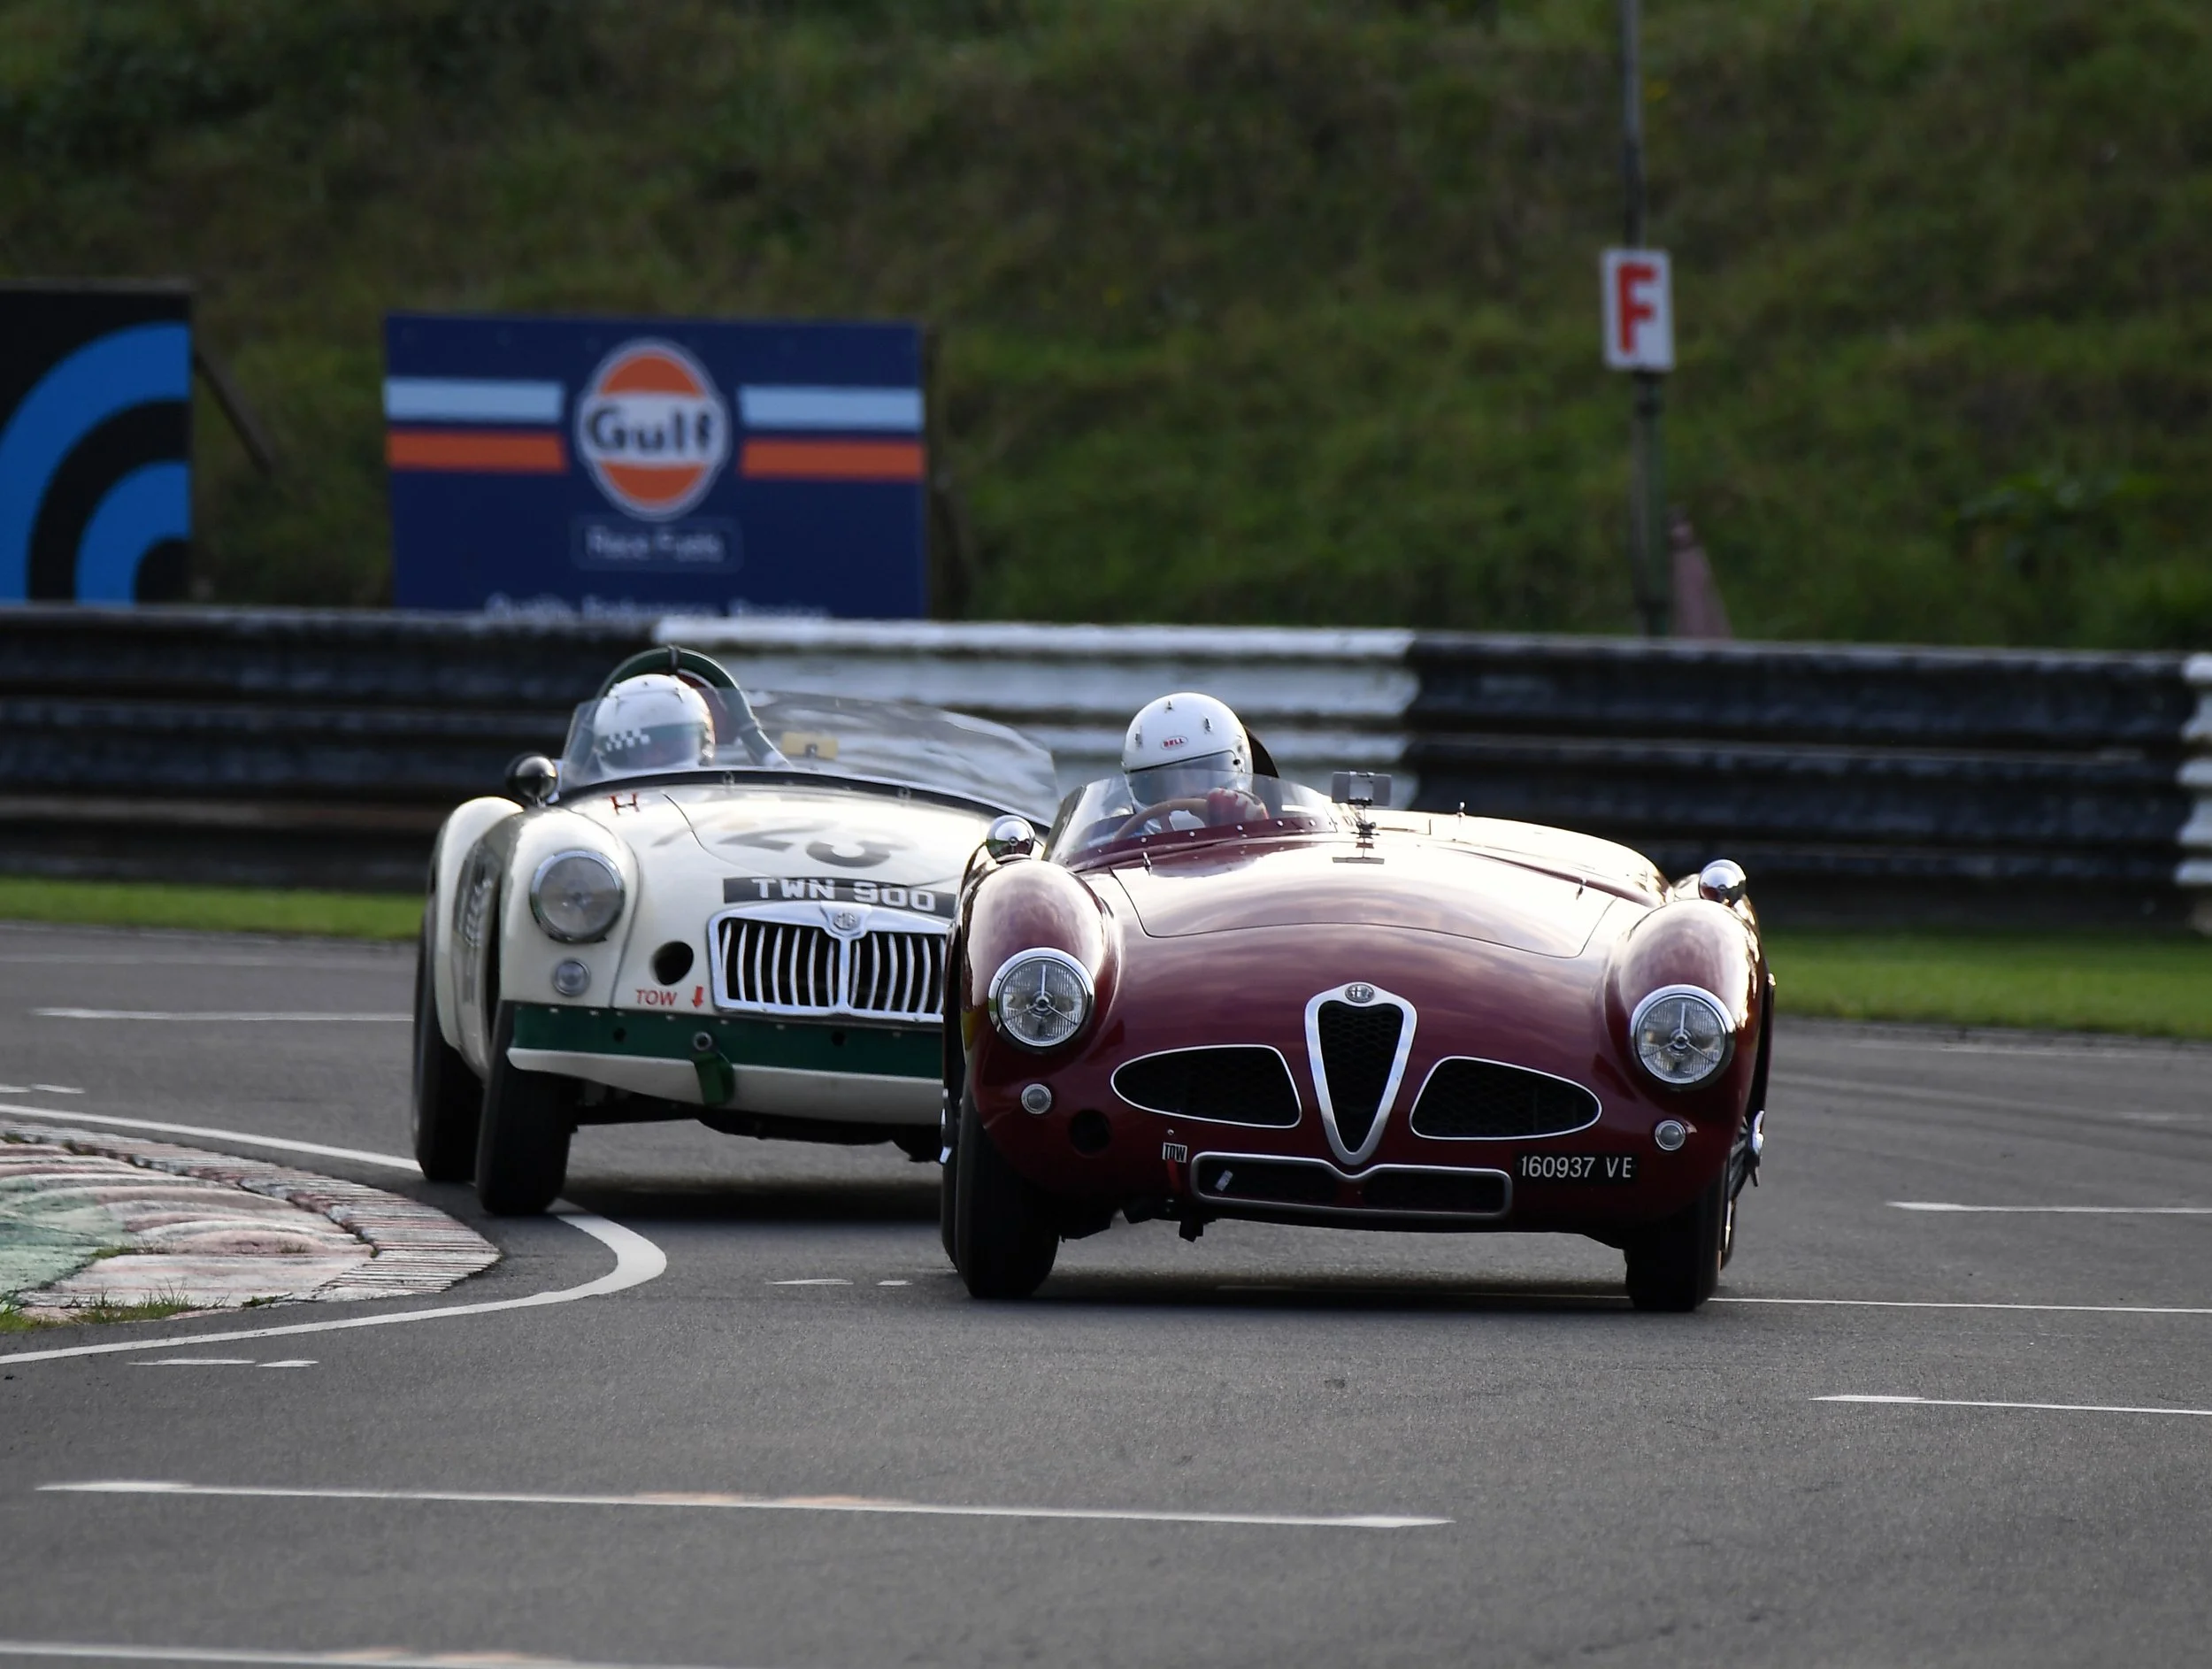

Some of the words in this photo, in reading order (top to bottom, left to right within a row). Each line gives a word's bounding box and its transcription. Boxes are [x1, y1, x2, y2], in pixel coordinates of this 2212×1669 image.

[1615, 262, 1659, 357] F
[587, 407, 710, 456] Gulf
[1163, 737, 1185, 748] BELL
[751, 878, 836, 900] TWN
[853, 881, 936, 912] 900
[635, 988, 678, 1006] TOW
[1164, 1143, 1187, 1162] TOW
[1521, 1155, 1596, 1178] 160937
